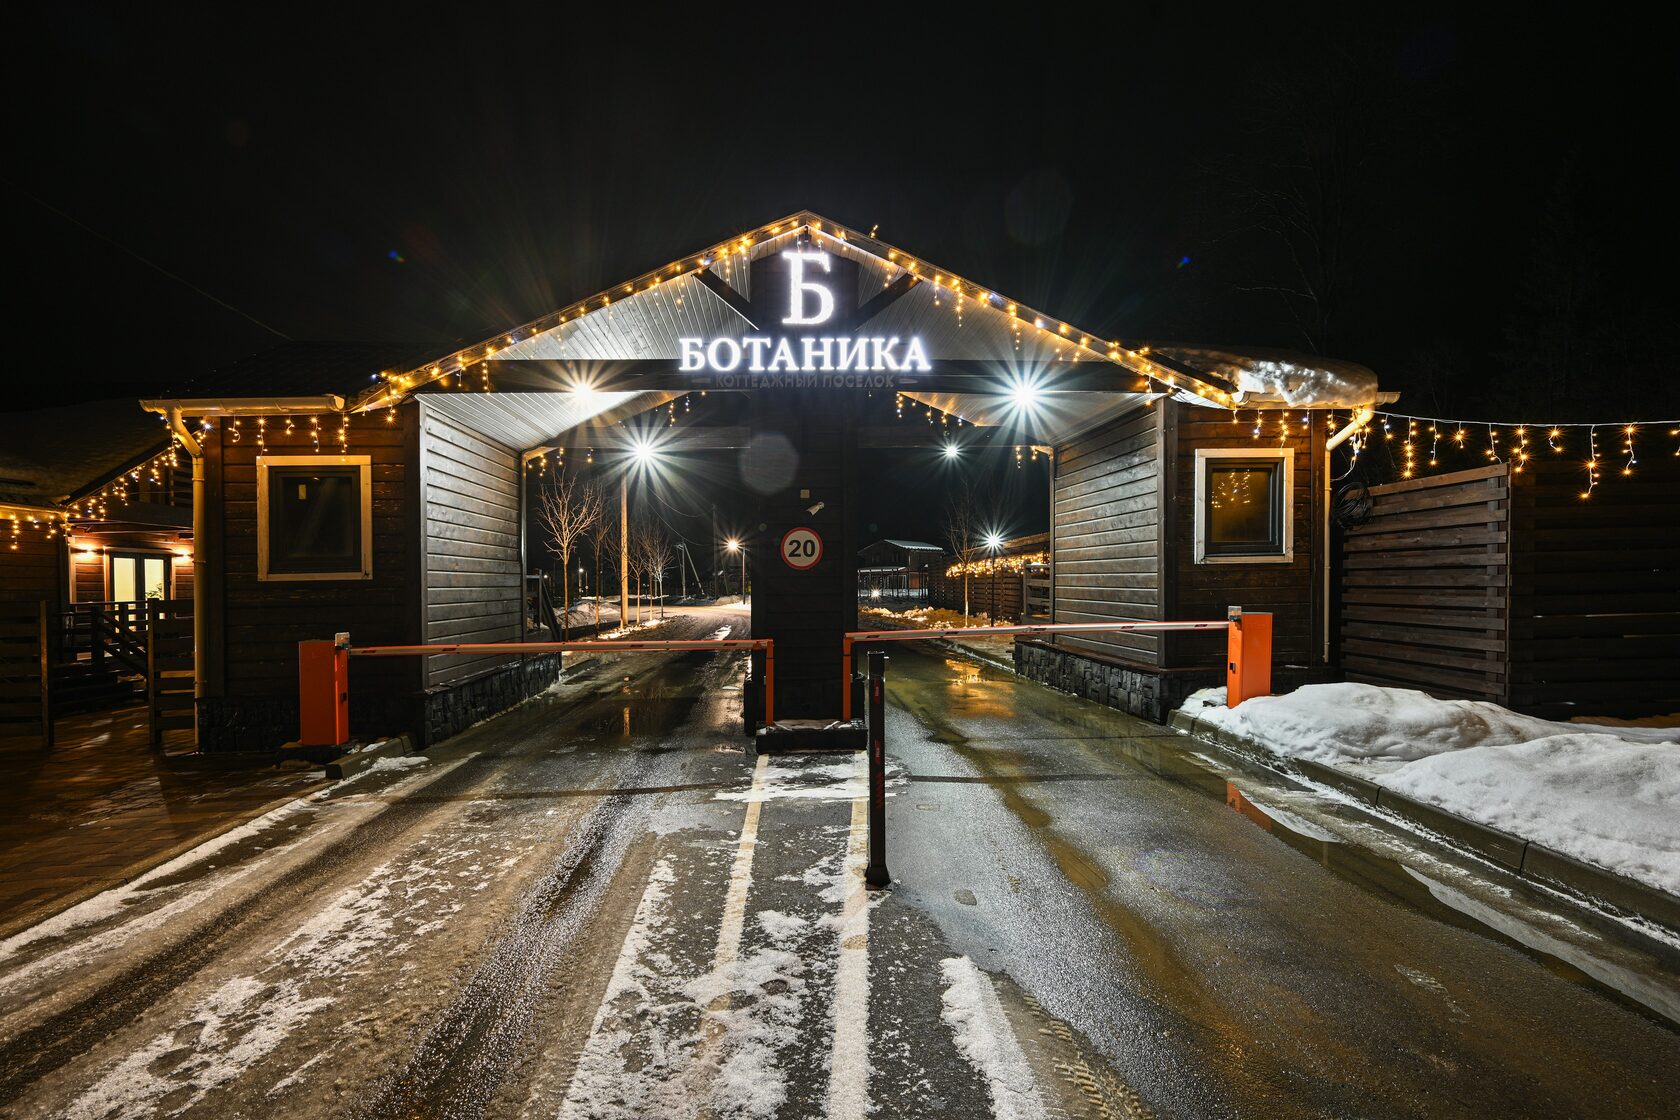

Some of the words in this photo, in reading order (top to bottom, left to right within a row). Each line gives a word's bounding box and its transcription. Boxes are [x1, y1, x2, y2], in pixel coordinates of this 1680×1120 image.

[781, 250, 835, 326] Б
[678, 336, 932, 372] БОТАНИКА
[715, 373, 818, 388] КОТТЕДЖНЫЙ
[822, 374, 895, 388] ПОСЕЛОК
[788, 539, 816, 558] 20
